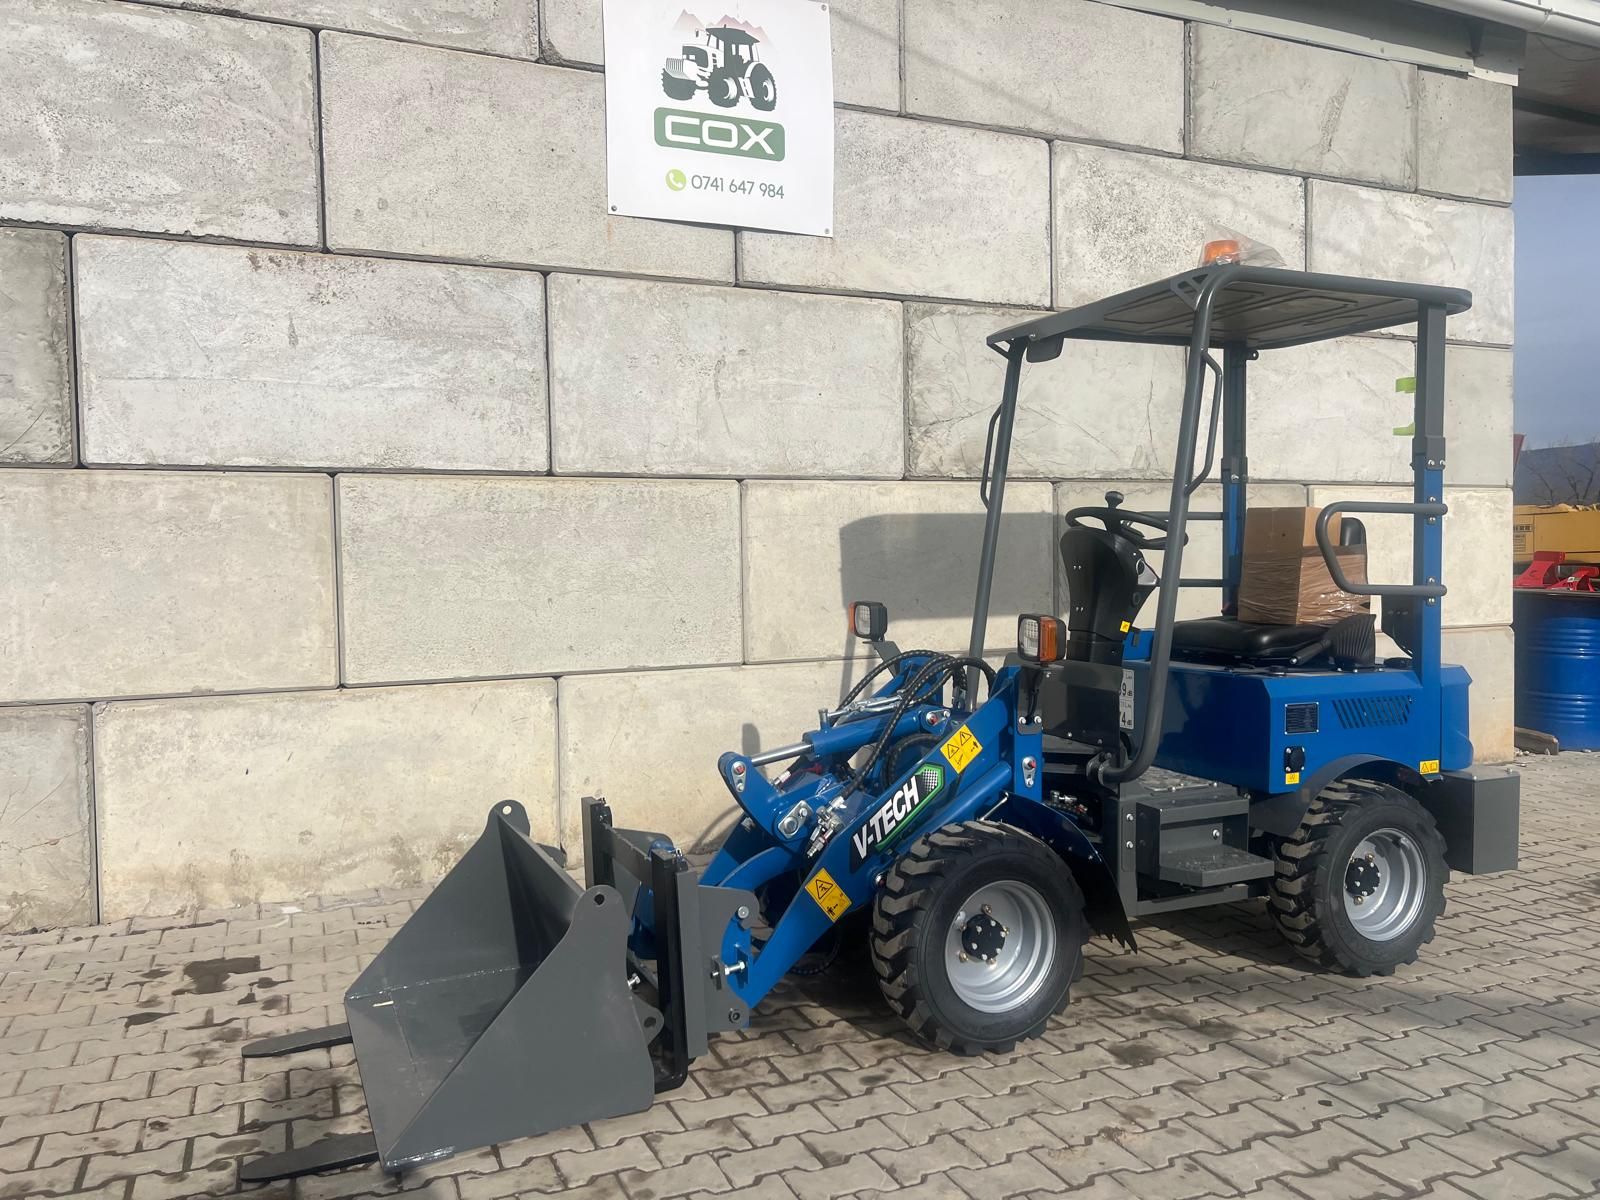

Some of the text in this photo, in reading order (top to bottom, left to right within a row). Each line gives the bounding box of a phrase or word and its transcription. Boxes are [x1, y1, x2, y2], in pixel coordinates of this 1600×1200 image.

[664, 115, 775, 155] COX
[691, 174, 785, 199] 0741 647 984
[852, 775, 920, 860] V-TECH
